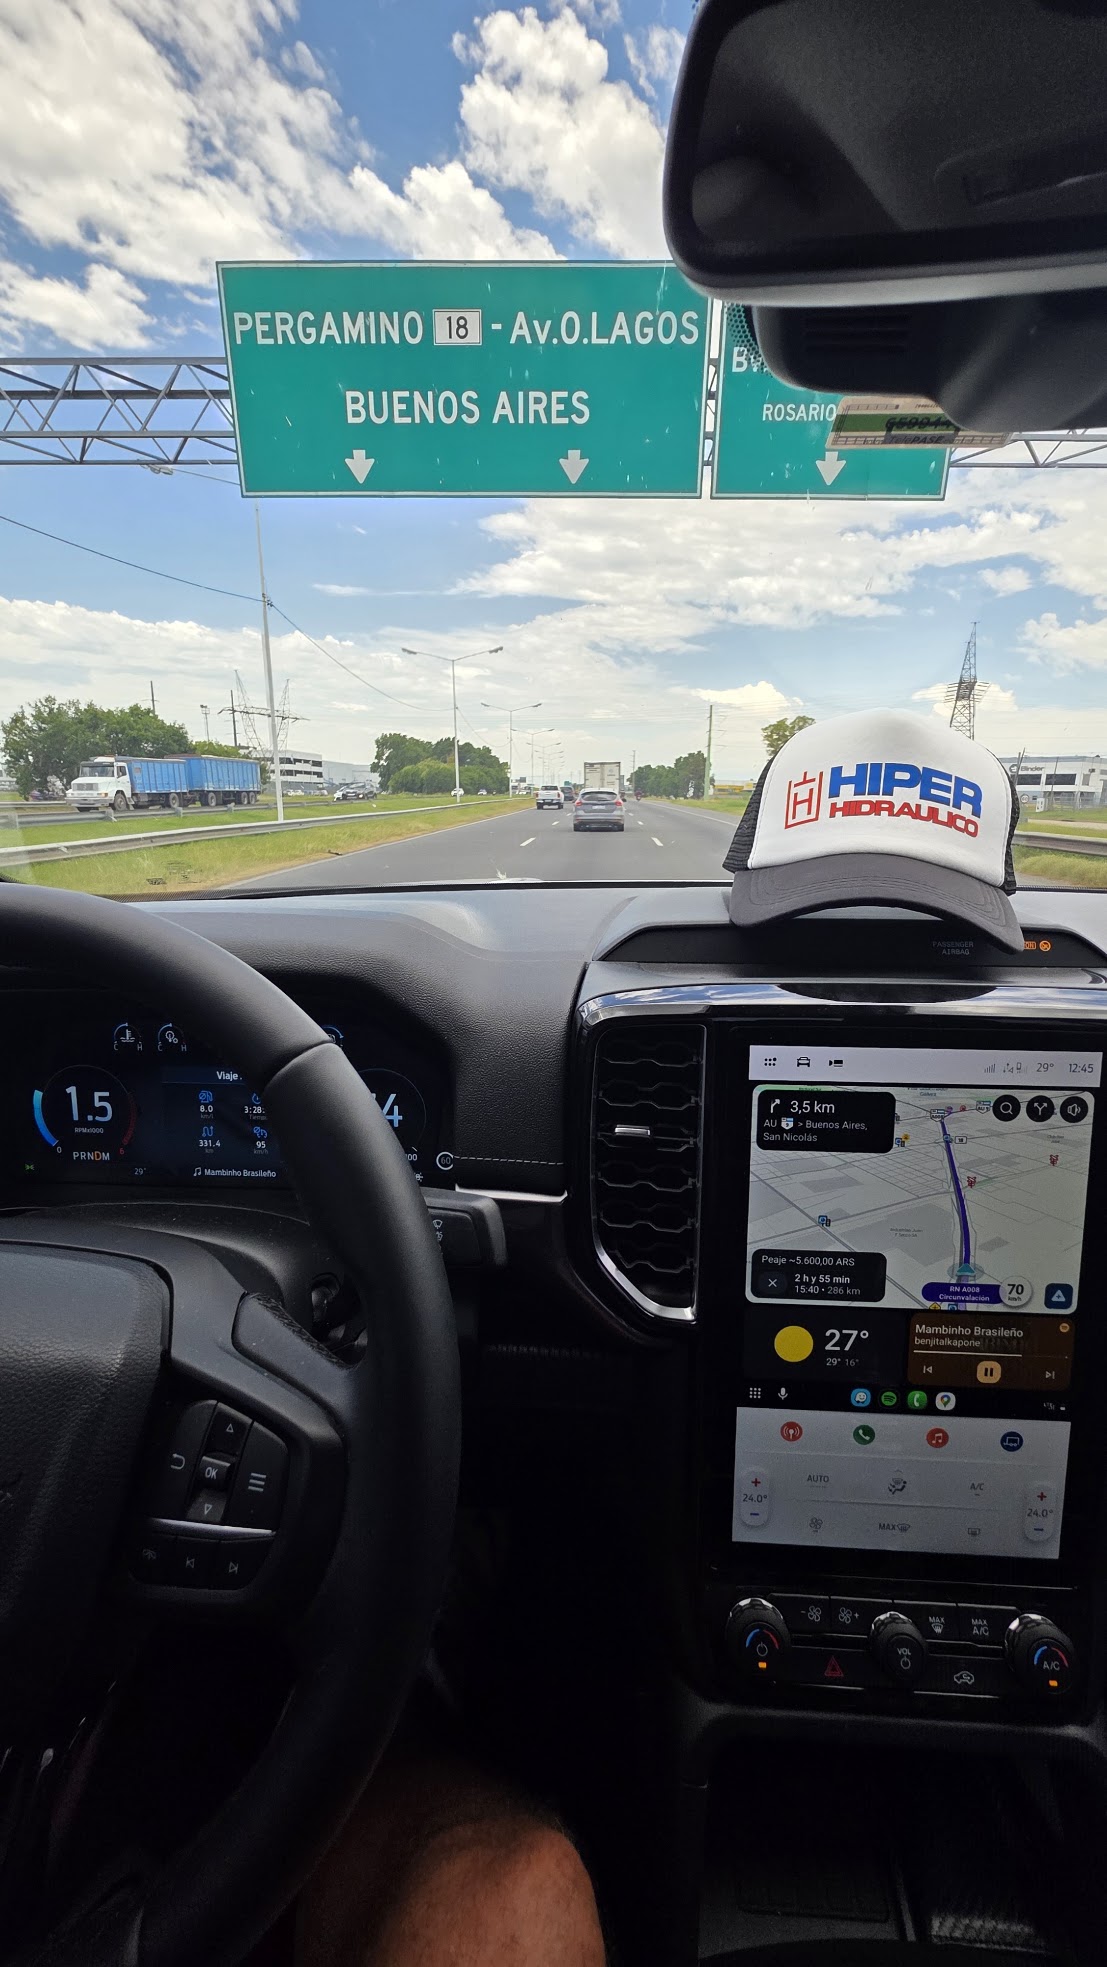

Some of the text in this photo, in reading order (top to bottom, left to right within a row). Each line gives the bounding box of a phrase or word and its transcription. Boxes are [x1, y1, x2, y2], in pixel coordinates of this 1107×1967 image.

[233, 311, 424, 346] PERGAMINO
[445, 315, 470, 340] 18
[510, 310, 699, 345] Av.O.LAGOS
[345, 390, 591, 425] BUENOS AIRES
[761, 403, 837, 422] ROSARIO
[828, 762, 983, 819] HIPER
[829, 800, 979, 838] HIDRAULICO
[932, 941, 975, 949] PASSENGER
[941, 948, 971, 956] AIRBAG
[1068, 1062, 1094, 1074] 12:45
[216, 1070, 239, 1081] Viaje
[65, 1085, 114, 1122] 1.5
[199, 1105, 214, 1113] 8.0
[790, 1100, 835, 1114] 3,5 km
[763, 1119, 777, 1128] AU
[805, 1120, 840, 1129] Buenos
[842, 1121, 868, 1131] Aires,
[763, 1132, 818, 1142] San Nicolás
[198, 1139, 221, 1148] 331.4
[255, 1140, 266, 1149] 95
[440, 1156, 451, 1165] 60
[204, 1168, 277, 1178] Mambinho Brasileño
[761, 1255, 787, 1267] Peaje
[835, 1256, 855, 1267] ARS
[794, 1273, 851, 1286] 2 h y 55 min
[794, 1284, 861, 1295] 15:40 286 km
[1007, 1283, 1024, 1295] 70
[938, 1293, 990, 1302] Circunvalación
[915, 1324, 1024, 1338] Mambinho Brasileño
[824, 1328, 869, 1351] 27°
[914, 1336, 981, 1348] benjitalkapone
[826, 1357, 859, 1367] 29° 16°
[205, 1466, 218, 1480] OK
[806, 1474, 830, 1484] AUTO
[969, 1482, 985, 1491] A/C
[742, 1493, 768, 1503] 24.0°
[1026, 1508, 1054, 1518] 24.0°
[878, 1522, 896, 1531] MAX
[928, 1616, 946, 1624] MAX
[971, 1618, 988, 1626] MAX
[972, 1626, 990, 1636] A/C
[1042, 1660, 1060, 1671] A/C
